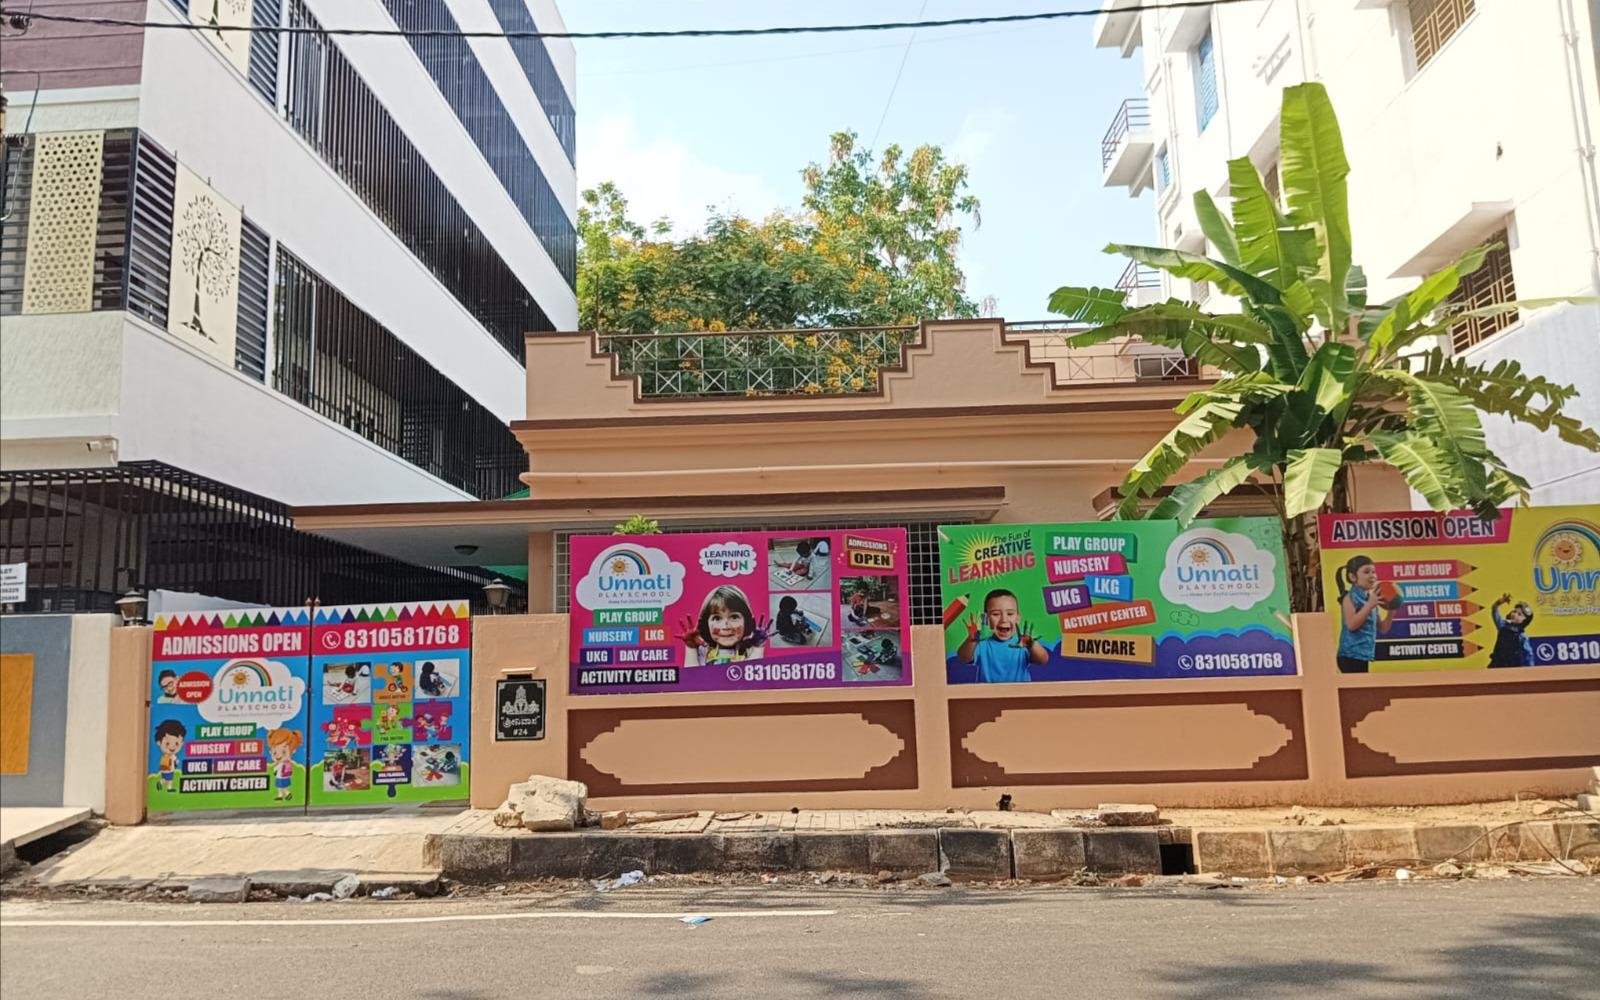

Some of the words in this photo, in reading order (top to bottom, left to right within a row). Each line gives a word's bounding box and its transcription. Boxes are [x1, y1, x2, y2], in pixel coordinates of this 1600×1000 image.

[994, 536, 1007, 544] The
[1008, 532, 1022, 540] Fun
[1023, 529, 1031, 538] of
[1333, 518, 1438, 542] ADMISSION
[1443, 517, 1495, 539] OPEN
[848, 538, 887, 550] ADMISSIONS
[974, 538, 1031, 561] CREATIVE
[1053, 536, 1081, 551] PLAY
[1083, 537, 1125, 552] GROUP
[704, 550, 750, 558] LEARNING
[854, 553, 890, 566] OPEN
[723, 560, 748, 571] FUN
[949, 551, 1036, 584] LEARNING
[1054, 556, 1109, 575] NURSERY
[1393, 565, 1416, 577] PLAY
[1418, 563, 1452, 576] GROUP
[1177, 564, 1259, 583] Unnati
[599, 574, 671, 591] Unnati
[1094, 578, 1119, 595] LKG
[1051, 588, 1080, 607] UKG
[1405, 585, 1450, 598] NURSERY
[600, 612, 622, 623] PLAY
[625, 611, 658, 623] GROUP
[1063, 613, 1108, 629] ACTIVITY
[1110, 606, 1147, 622] CENTER
[1408, 605, 1429, 616] LKG
[1439, 604, 1462, 614] UKG
[344, 625, 459, 648] 8310581768
[588, 631, 633, 642] NURSERY
[645, 629, 664, 641] LKG
[1410, 623, 1453, 636] DAYCARE
[161, 634, 259, 655] ADMISSIONS
[262, 632, 302, 652] OPEN
[1077, 639, 1135, 655] DAYCARE
[1389, 645, 1426, 656] ACTIVITY
[1427, 643, 1458, 654] CENTER
[1557, 641, 1600, 661] 8310
[586, 651, 608, 662] UKG
[620, 650, 639, 661] DAY
[641, 649, 668, 661] CARE
[1195, 653, 1283, 670] 8310581768
[581, 670, 632, 684] ACTIVITY
[634, 669, 676, 682] CENTER
[744, 663, 836, 681] 8310581768
[218, 686, 293, 704] Unnati
[201, 726, 221, 737] PLAY
[223, 725, 254, 736] GROUP
[190, 743, 231, 754] NURSERY
[240, 742, 258, 753] LKG
[188, 761, 208, 773] UKG
[217, 760, 236, 771] DAY
[237, 759, 261, 770] CARE
[182, 779, 228, 791] ACTIVITY
[230, 777, 267, 790] CENTER
